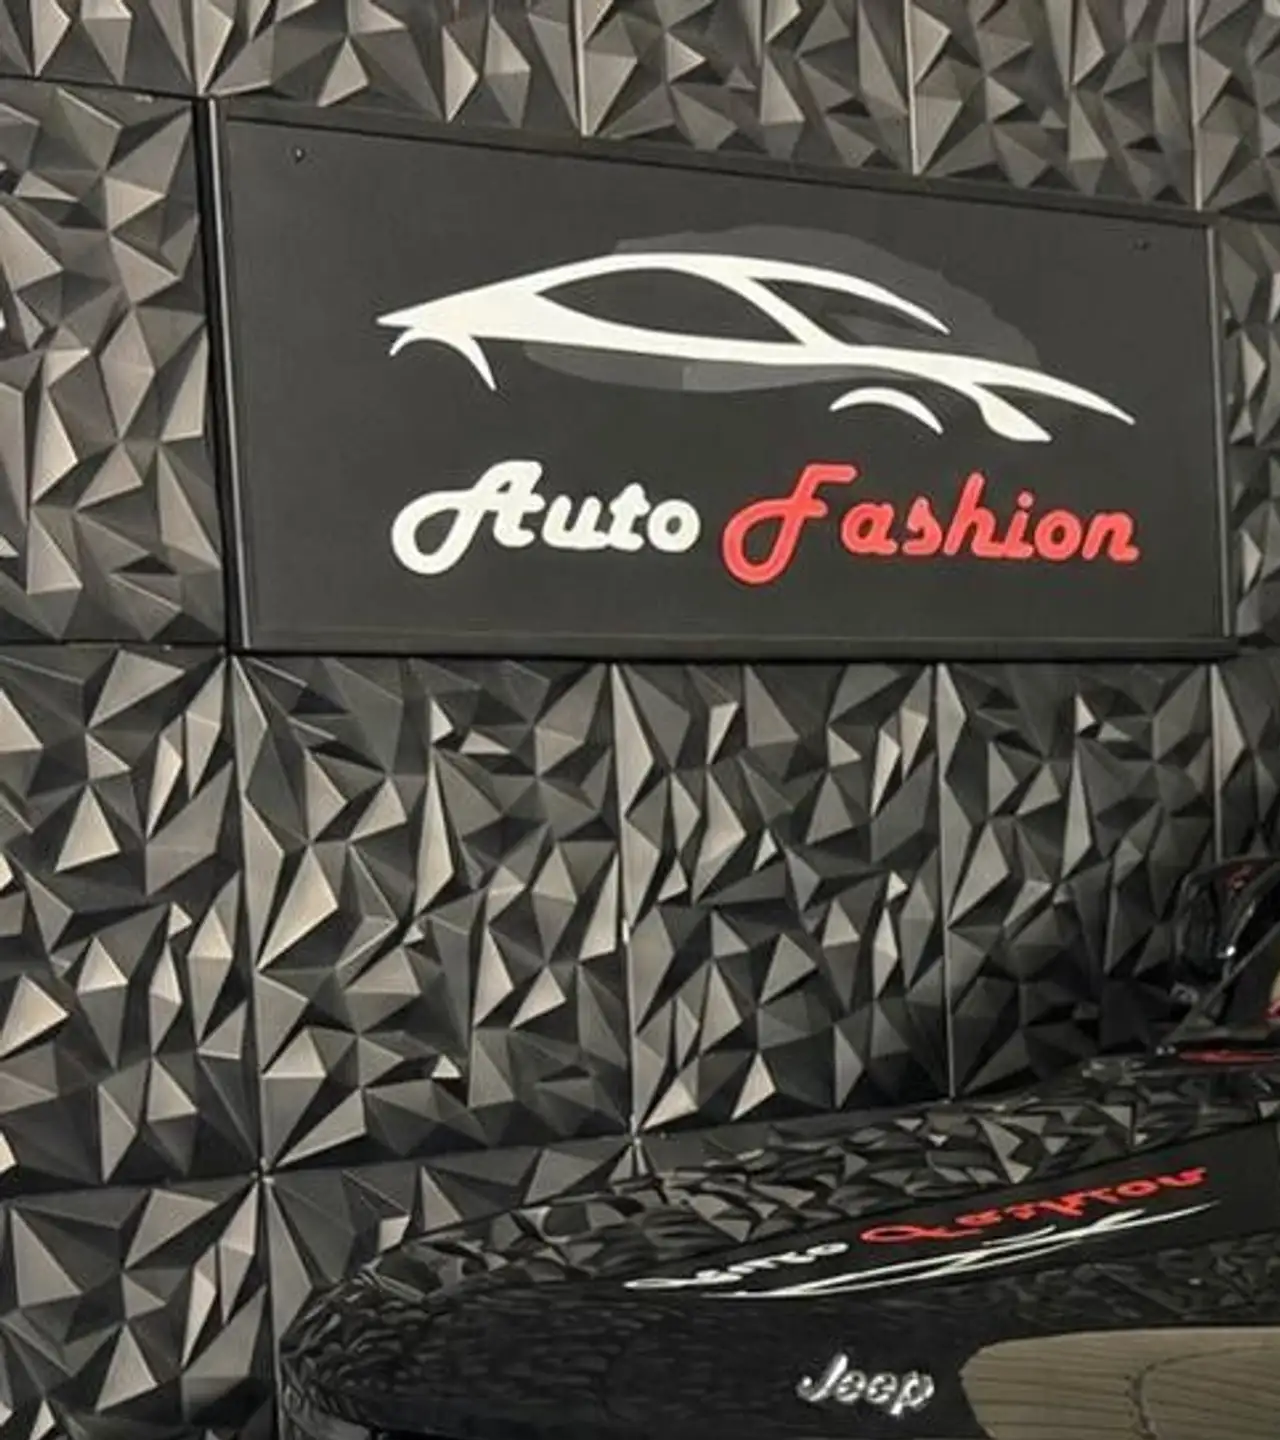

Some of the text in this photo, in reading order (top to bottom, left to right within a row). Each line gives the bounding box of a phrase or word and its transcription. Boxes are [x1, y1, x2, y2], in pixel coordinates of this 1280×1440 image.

[391, 459, 1141, 584] Auto Fashion
[797, 1353, 935, 1415] Jeep
